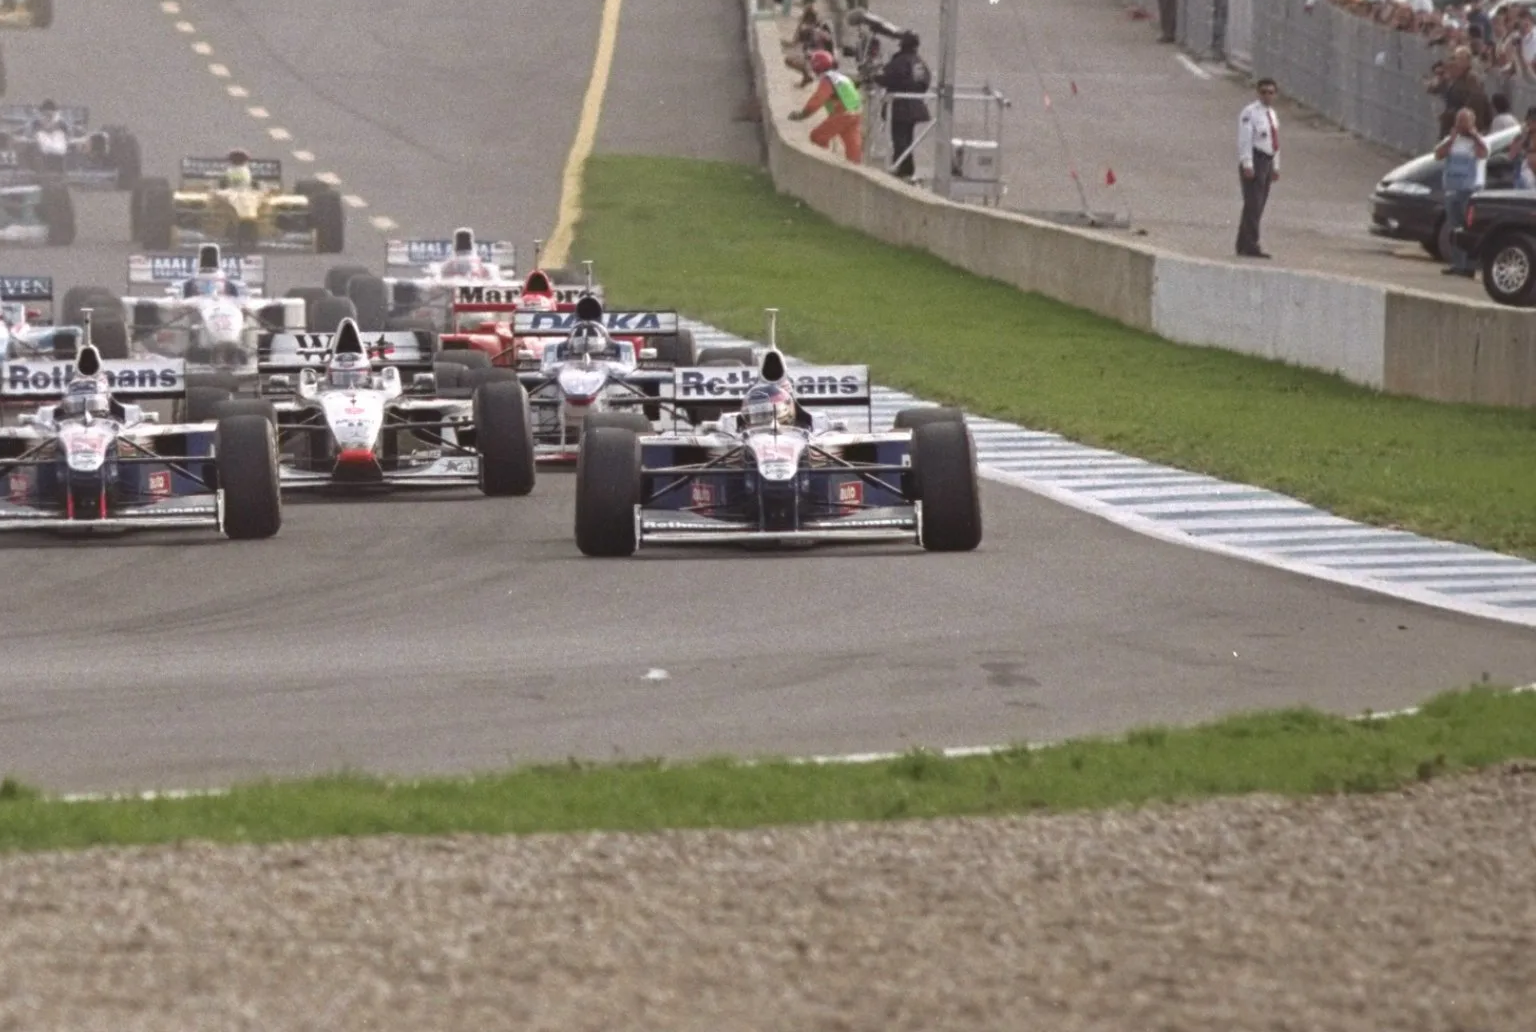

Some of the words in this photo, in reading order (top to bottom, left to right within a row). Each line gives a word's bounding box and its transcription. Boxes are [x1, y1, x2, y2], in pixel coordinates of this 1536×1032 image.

[458, 286, 594, 303] Maror
[531, 313, 660, 329] DKA
[9, 365, 177, 390] Rotans
[682, 371, 859, 396] Rothans
